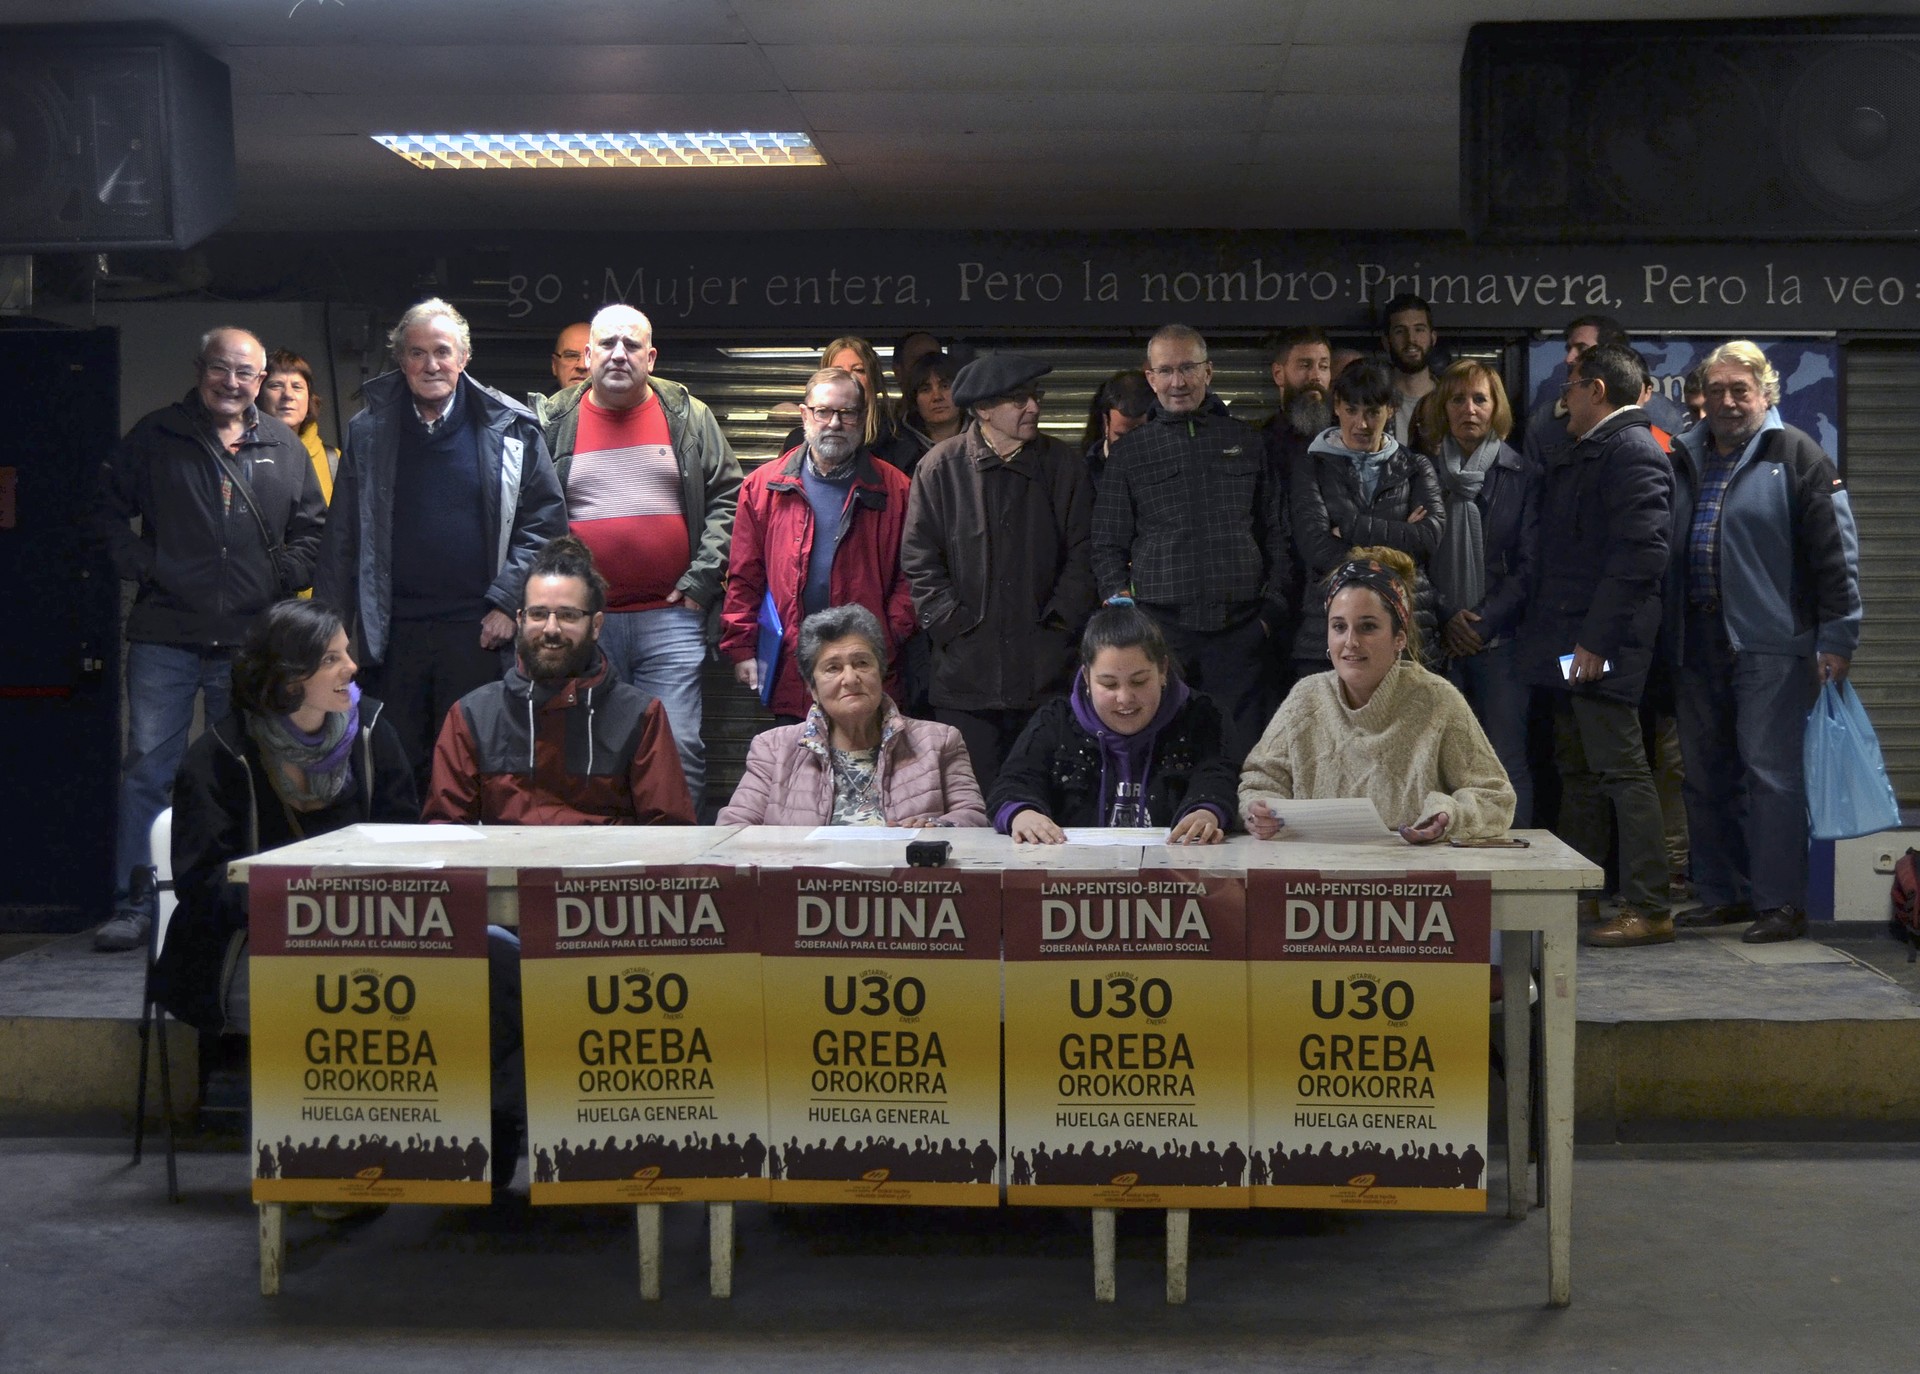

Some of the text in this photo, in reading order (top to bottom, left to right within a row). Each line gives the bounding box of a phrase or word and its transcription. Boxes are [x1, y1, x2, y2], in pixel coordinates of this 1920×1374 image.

[766, 269, 932, 308] entera,
[959, 261, 1063, 302] Pero
[1083, 259, 1119, 302] la
[1643, 264, 1746, 305] Pero
[1764, 263, 1801, 305] la
[287, 879, 449, 893] LAN-PENTSIO-BIZITZA
[555, 877, 719, 893] LAN-PENTSIO-BIZITZA
[797, 879, 962, 894] LAN-PENTSIO-BIZITZA
[1041, 882, 1207, 895] LAN-PENTSIO-BIZITZA
[1286, 883, 1452, 897] LAN-PENTSIO-BIZITZA
[288, 896, 453, 937] DUINA
[557, 894, 725, 937] DUINA
[798, 896, 965, 938] DUINA
[1042, 899, 1210, 940] DUINA
[1286, 900, 1454, 942] DUINA
[286, 939, 452, 949] SOBERANÍA PARA EL CAMBIO SOCIAL
[556, 938, 725, 950] SOBERANÍA PARA EL CAMBIO SOCIAL
[795, 939, 848, 948] SOBERANÍA
[851, 941, 875, 949] PARA
[890, 942, 927, 951] CAMBIO
[930, 943, 964, 951] SOCIAL
[1040, 943, 1094, 953] SOBERANÍA
[1096, 944, 1120, 952] PARA
[1136, 943, 1173, 951] CAMBIO
[1176, 943, 1210, 951] SOCIAL
[1283, 944, 1453, 954] SOBERANÍA PARA EL CAMBIO SOCIAL
[316, 974, 415, 1015] U30
[588, 973, 688, 1014] U30
[825, 975, 925, 1016] U30
[1071, 978, 1172, 1018] U30
[1313, 979, 1414, 1020] U30
[305, 1028, 437, 1065] GREBA
[579, 1028, 712, 1065] GREBA
[813, 1029, 947, 1067] GREBA
[1059, 1033, 1194, 1070] GREBA
[1301, 1034, 1435, 1072] GREBA
[304, 1069, 438, 1092] OROKORRA
[579, 1068, 714, 1092] OROKORRA
[812, 1070, 947, 1094] OROKORRA
[1059, 1074, 1195, 1096] OROKORRA
[1298, 1074, 1434, 1098] OROKORRA
[302, 1106, 441, 1122] HUELGA GENERAL
[577, 1106, 718, 1122] HUELGA GENERAL
[809, 1108, 949, 1124] HUELGA GENERAL
[1056, 1112, 1198, 1127] HUELGA GENERAL
[1295, 1112, 1436, 1129] HUELGA GENERAL
